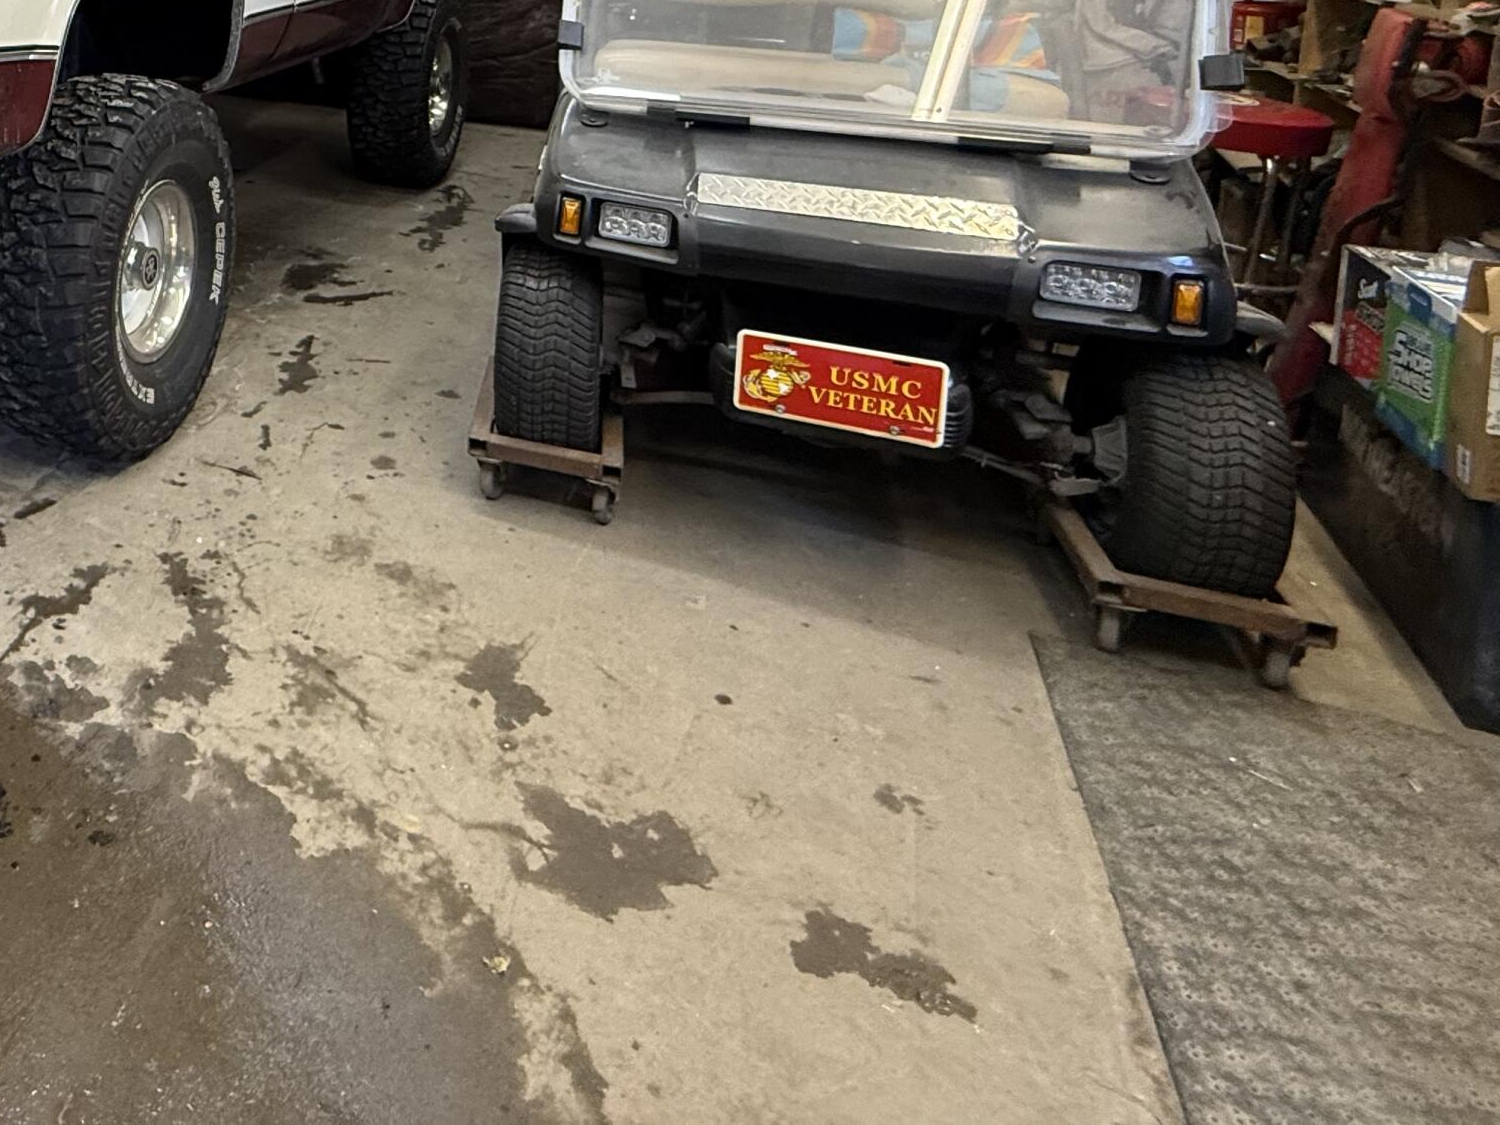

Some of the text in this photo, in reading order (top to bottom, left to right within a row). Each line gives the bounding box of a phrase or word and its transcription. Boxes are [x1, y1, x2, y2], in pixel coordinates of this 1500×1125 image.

[210, 221, 226, 305] CEPEK
[830, 365, 922, 399] USMC
[808, 386, 937, 425] VETERAN
